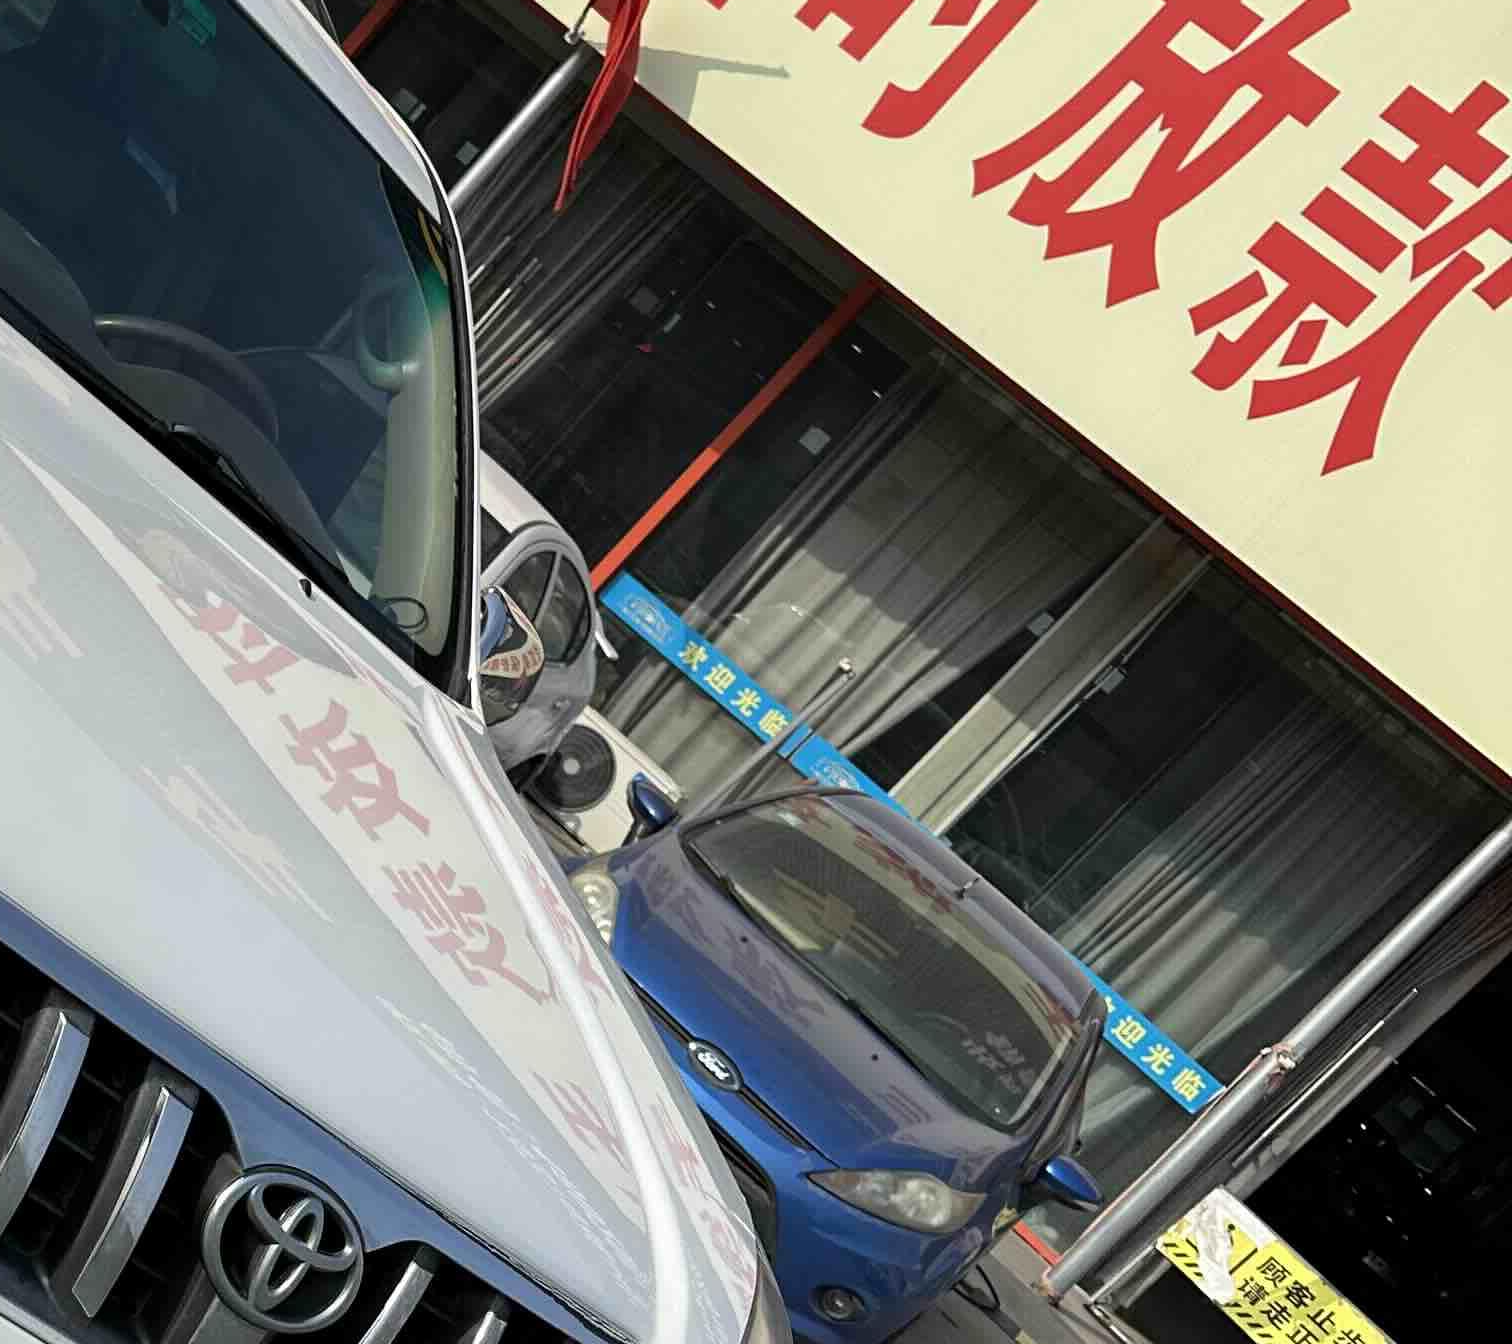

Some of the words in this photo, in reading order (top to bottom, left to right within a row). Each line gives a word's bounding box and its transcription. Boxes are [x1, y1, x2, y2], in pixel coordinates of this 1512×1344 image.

[677, 640, 789, 740] 欢迎光临
[1102, 994, 1206, 1103] 迎光临
